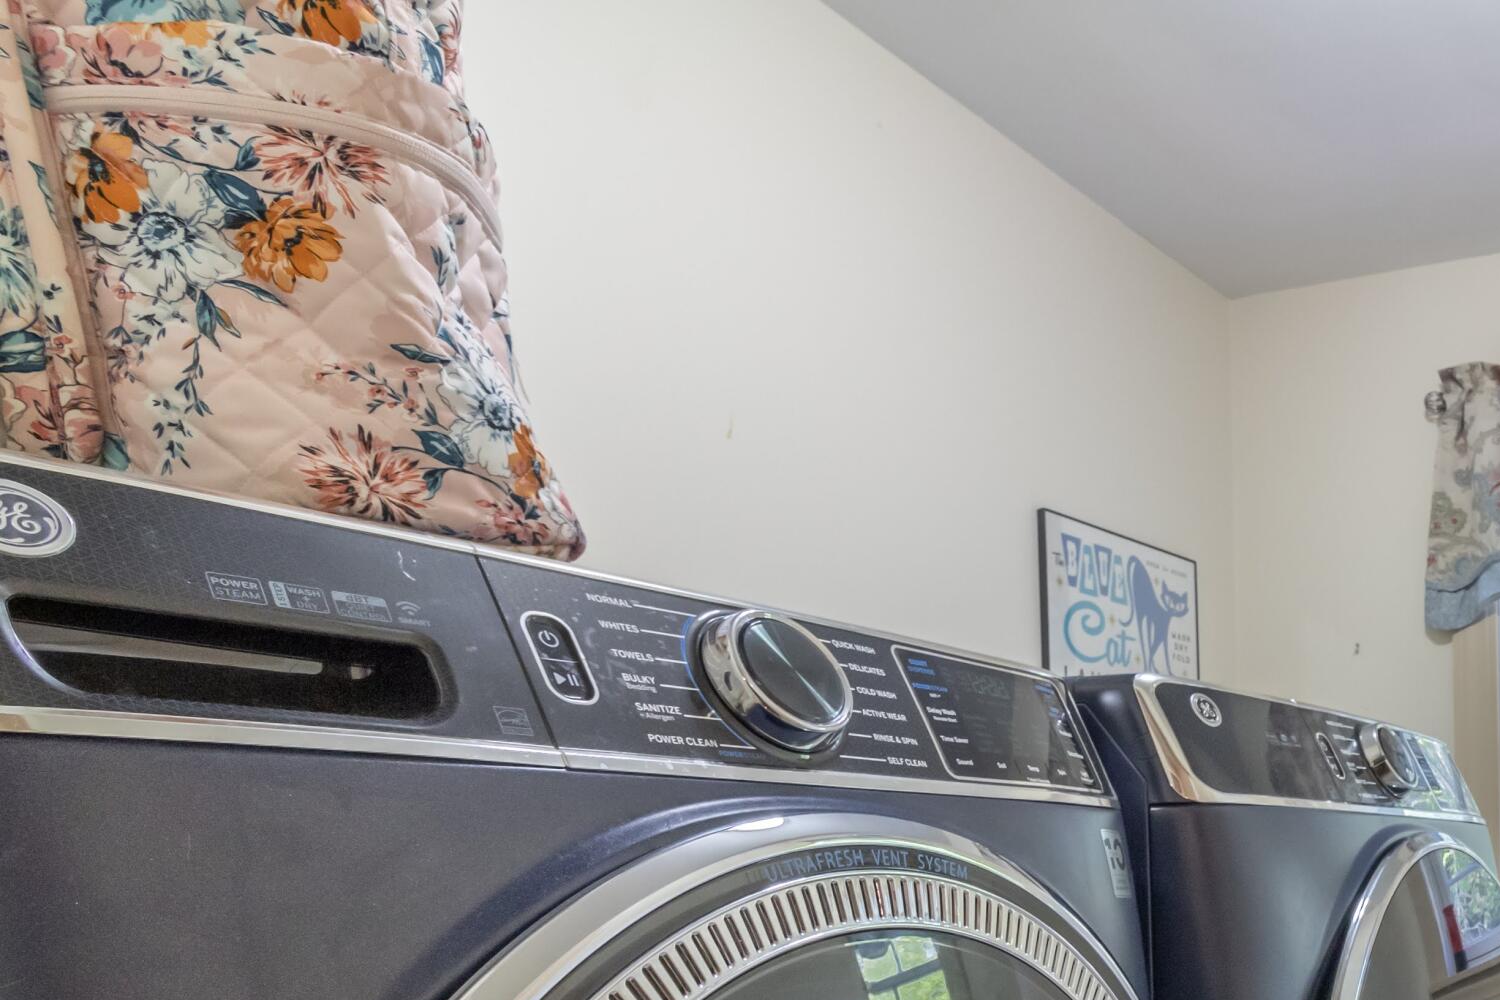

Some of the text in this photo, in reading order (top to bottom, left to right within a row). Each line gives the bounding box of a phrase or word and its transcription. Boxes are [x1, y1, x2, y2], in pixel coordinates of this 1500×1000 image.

[209, 576, 259, 590] POWER
[214, 586, 261, 601] STEAM
[286, 586, 321, 598] WASH
[585, 592, 633, 609] NORMAL
[598, 619, 640, 634] WHITES
[1063, 600, 1136, 668] Cat
[831, 639, 854, 650] QUICK
[611, 648, 656, 662] TOWELS
[848, 663, 886, 677] DELICATES
[621, 672, 656, 685] BULKY
[856, 685, 876, 697] COLD
[634, 702, 683, 716] SANITIZE
[862, 709, 907, 722] ACTIVE WEAR
[648, 733, 718, 749] POWER CLEAN
[887, 756, 928, 768] SELF CLEAN
[763, 848, 968, 883] ULTRAFRESH VENT SYSTEM
